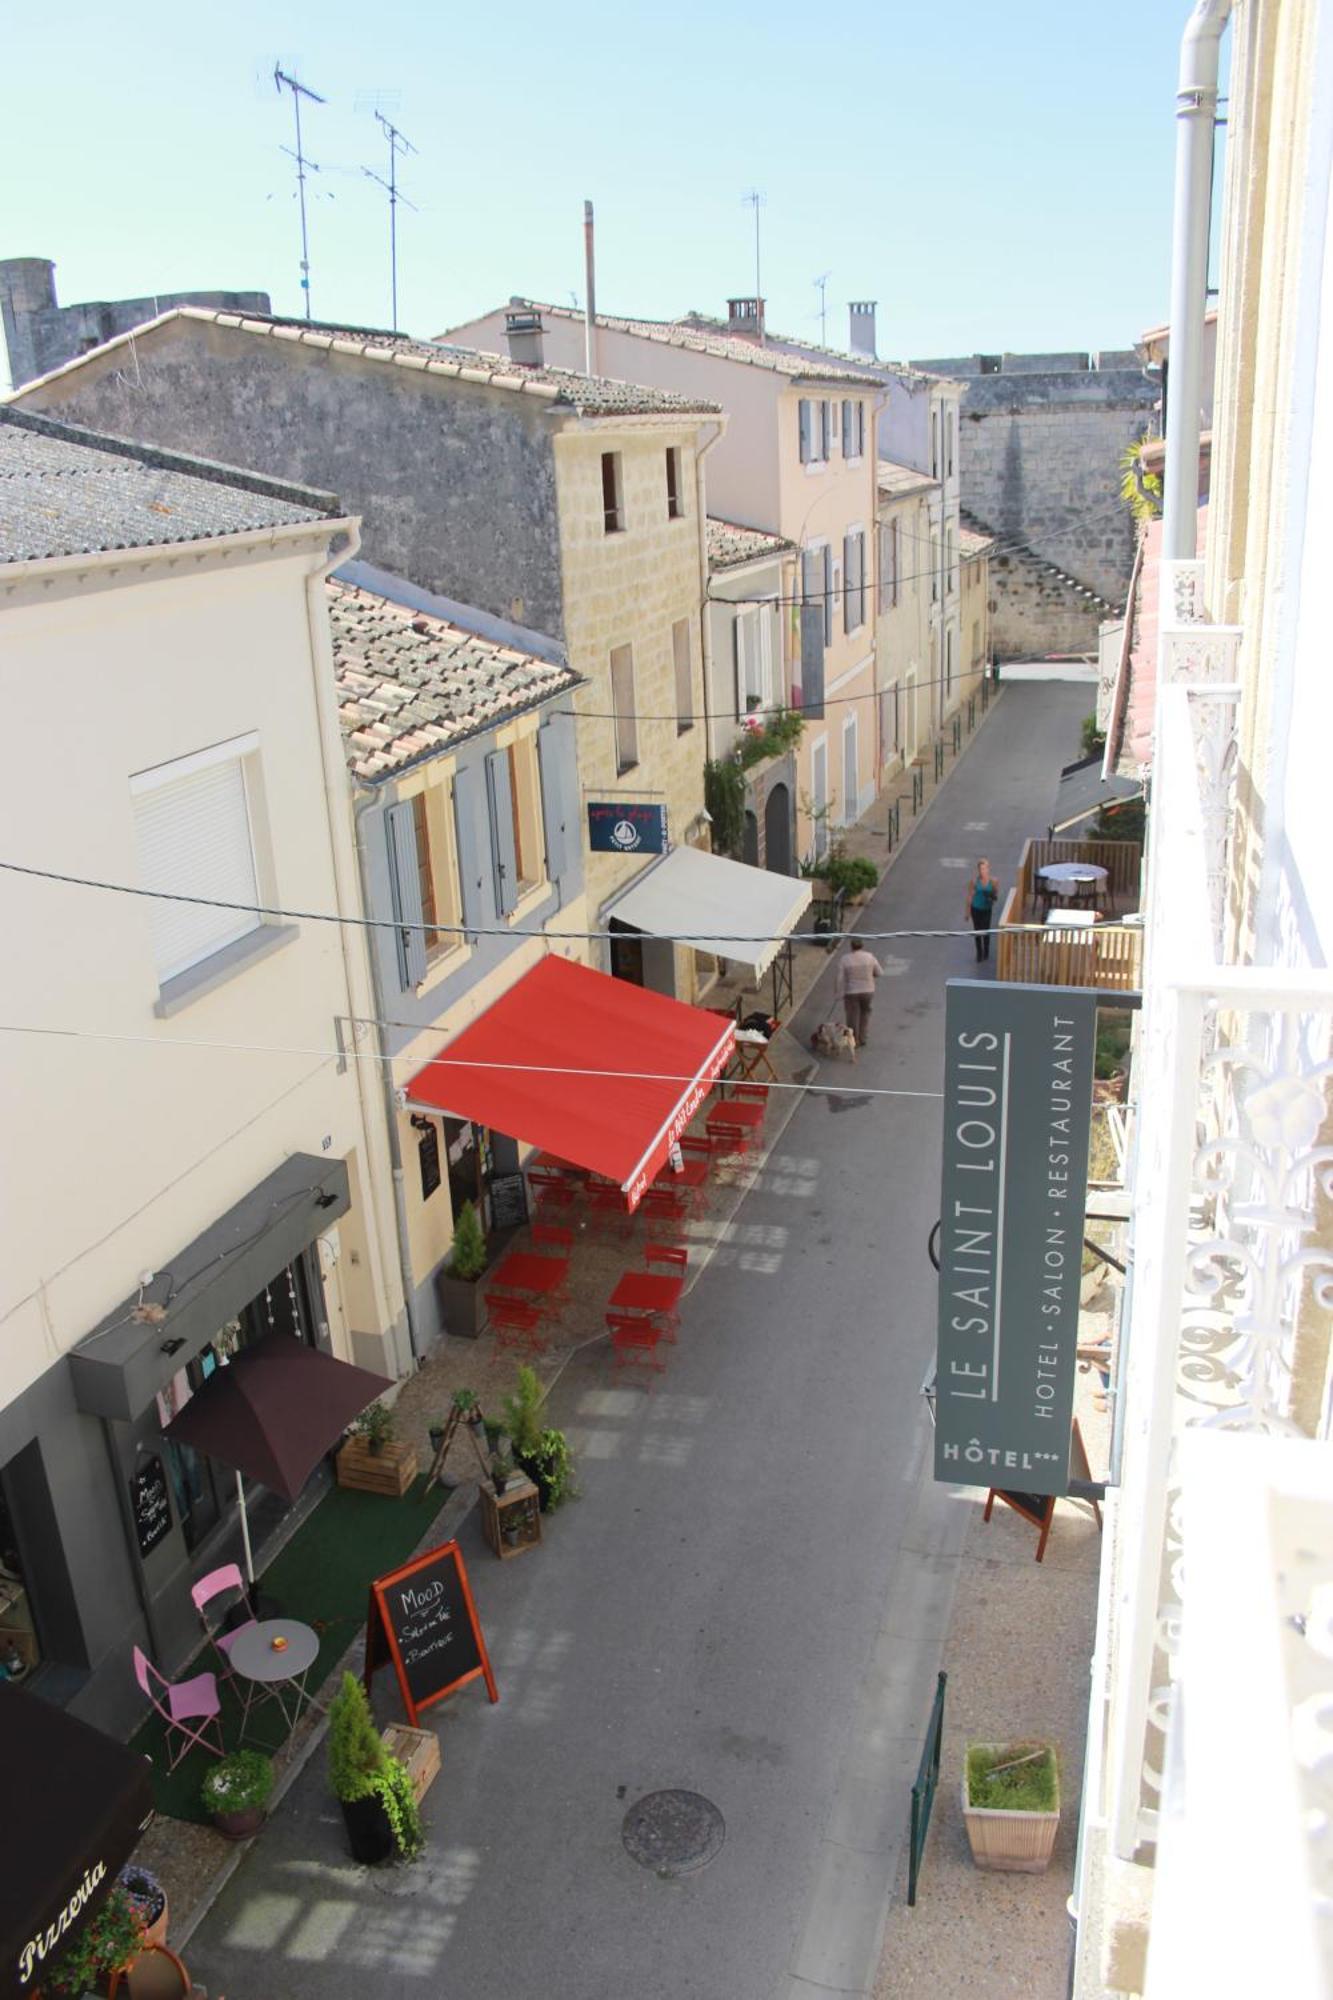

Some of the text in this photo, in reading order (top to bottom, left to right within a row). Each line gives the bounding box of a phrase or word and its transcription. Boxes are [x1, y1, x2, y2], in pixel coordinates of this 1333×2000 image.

[951, 1031, 999, 1400] LE SAINT LOUIS
[1034, 1015, 1076, 1419] HOTEL SALON RESTAURANT
[18, 1860, 107, 1984] Pizzeria
